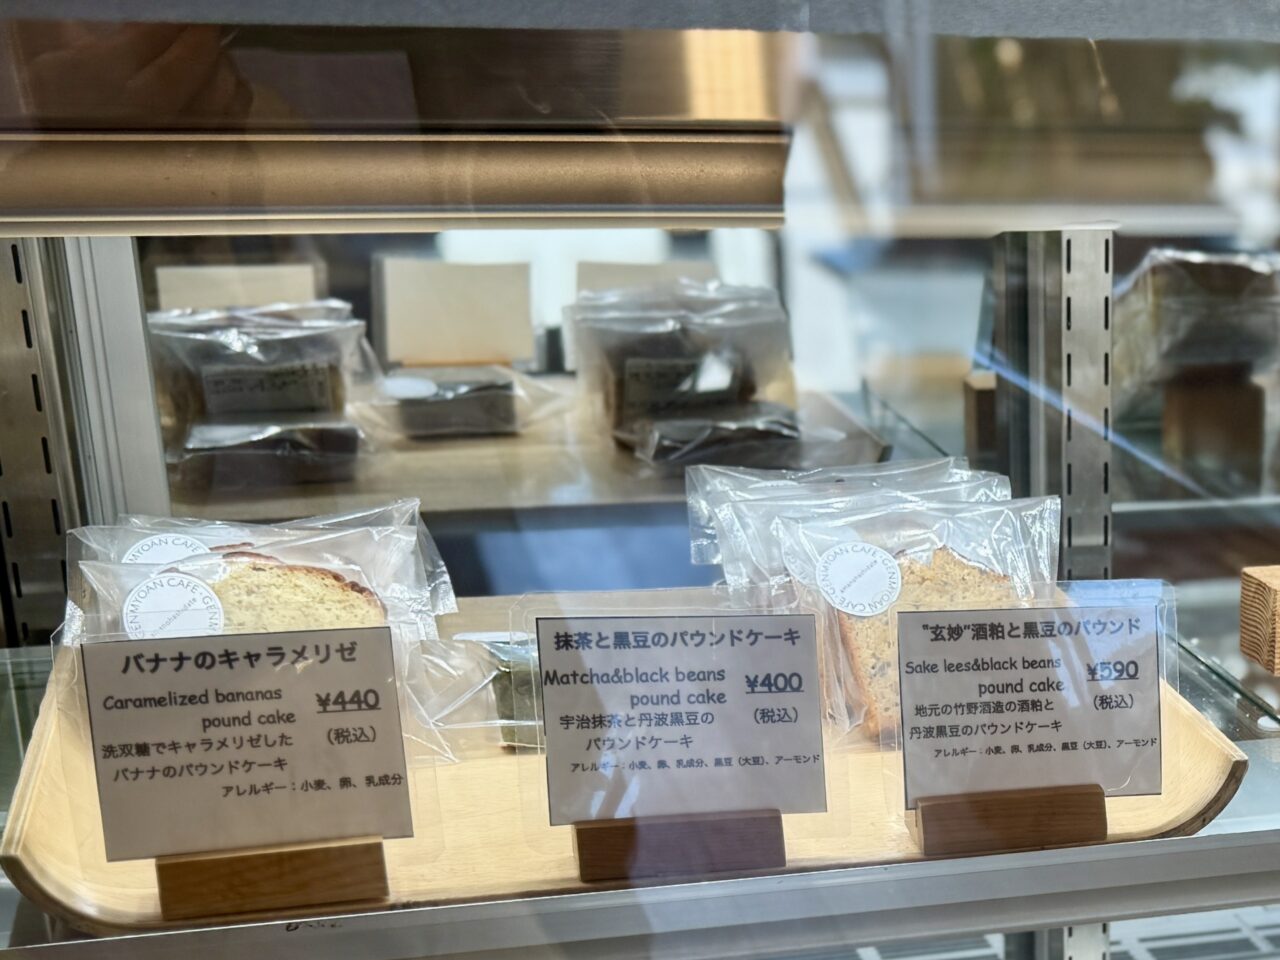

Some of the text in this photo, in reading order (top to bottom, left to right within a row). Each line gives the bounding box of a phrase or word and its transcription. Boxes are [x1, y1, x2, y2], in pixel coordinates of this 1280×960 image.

[172, 538, 199, 553] CAFE
[167, 577, 199, 594] CAFE
[554, 629, 800, 651] 抹茶と黒豆のパウンドケーキ
[121, 642, 357, 674] バナナのキャラメリゼ
[906, 657, 1060, 674] Sake lees&black beans
[544, 668, 726, 686] Matcha&black beans
[1087, 661, 1138, 680] ¥590
[746, 673, 804, 692] ¥400
[979, 679, 1064, 696] pound cake
[103, 688, 282, 710] Caramelized bananas
[316, 689, 380, 712] ¥440
[630, 690, 727, 708] pound cake
[1094, 695, 1134, 710] （税込）
[754, 708, 798, 724] （税込）
[914, 701, 1053, 716] 地元の竹野酒造の酒粕と
[202, 711, 296, 732] pound cake
[560, 711, 714, 729] 宇治抹茶と丹波黒豆の
[326, 728, 377, 745] （税込）
[910, 720, 1062, 740] 丹波黒豆のパウンドケーキ
[102, 733, 293, 759] 洗双糖でキャラメリゼした
[586, 735, 693, 750] パウンドケーキ
[114, 758, 288, 781] バナナのパウンドケーキ
